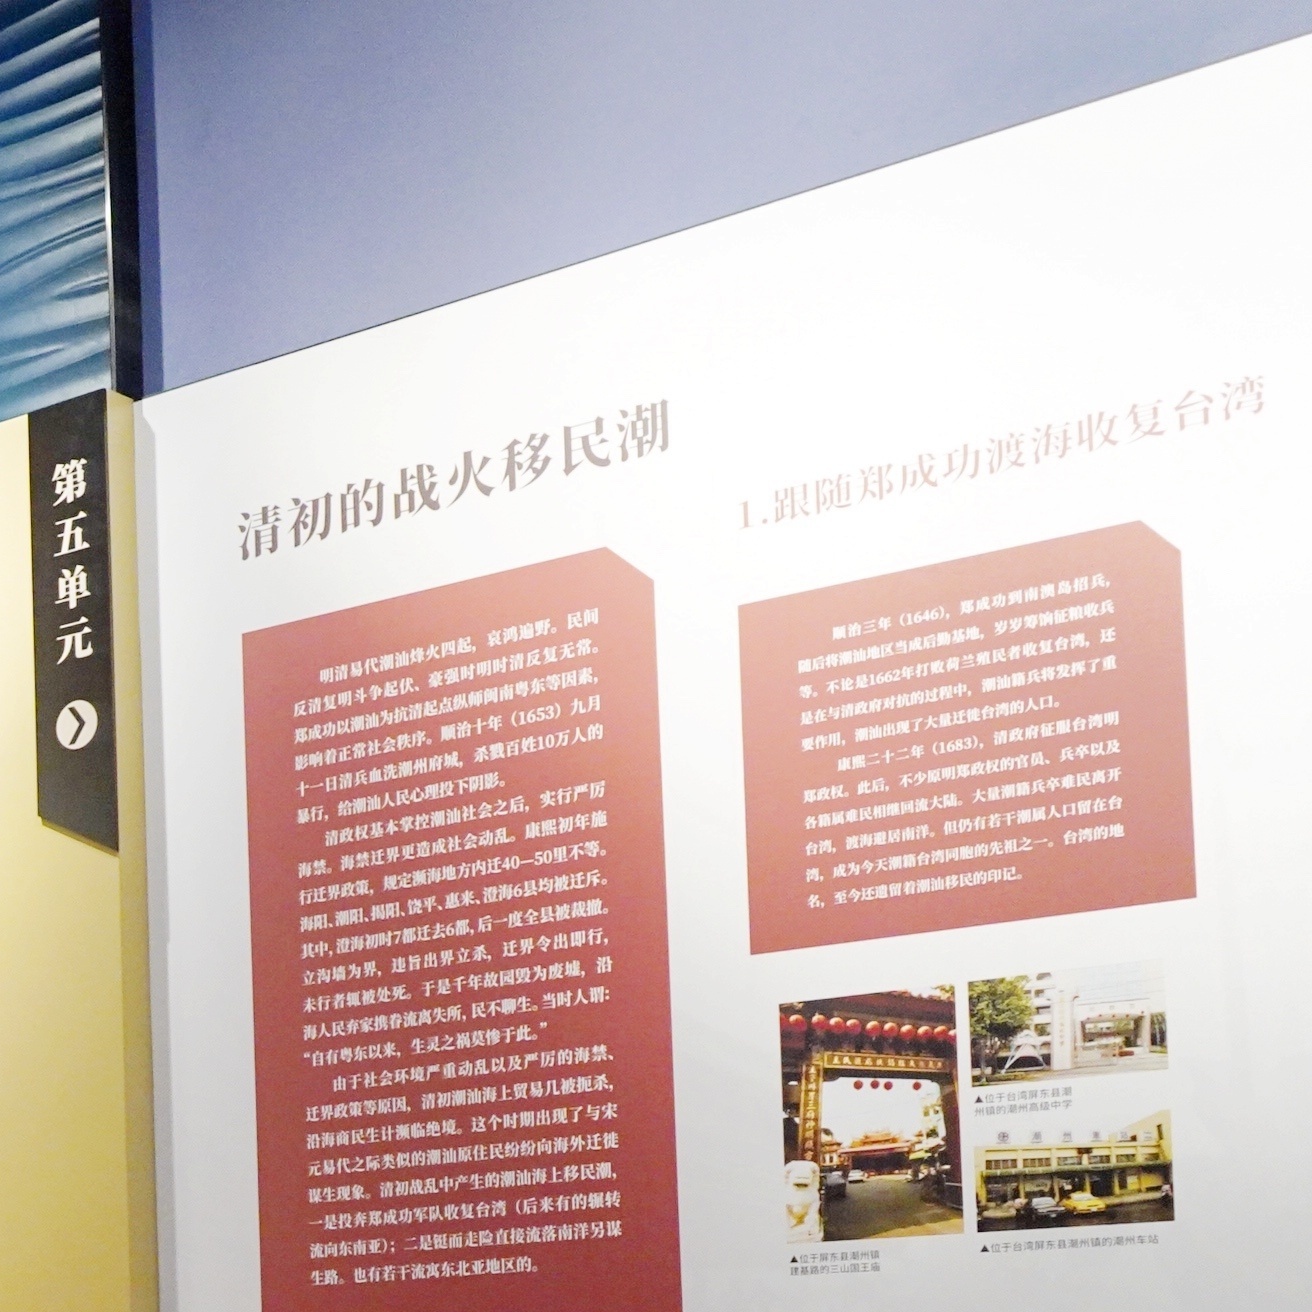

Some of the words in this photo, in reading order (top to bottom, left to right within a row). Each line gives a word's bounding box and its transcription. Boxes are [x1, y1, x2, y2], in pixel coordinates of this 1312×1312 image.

[237, 398, 670, 561] 清初的战火移民潮
[737, 375, 1266, 530] 1.跟随郑成功渡海收复台湾
[51, 457, 94, 665] 第五单元
